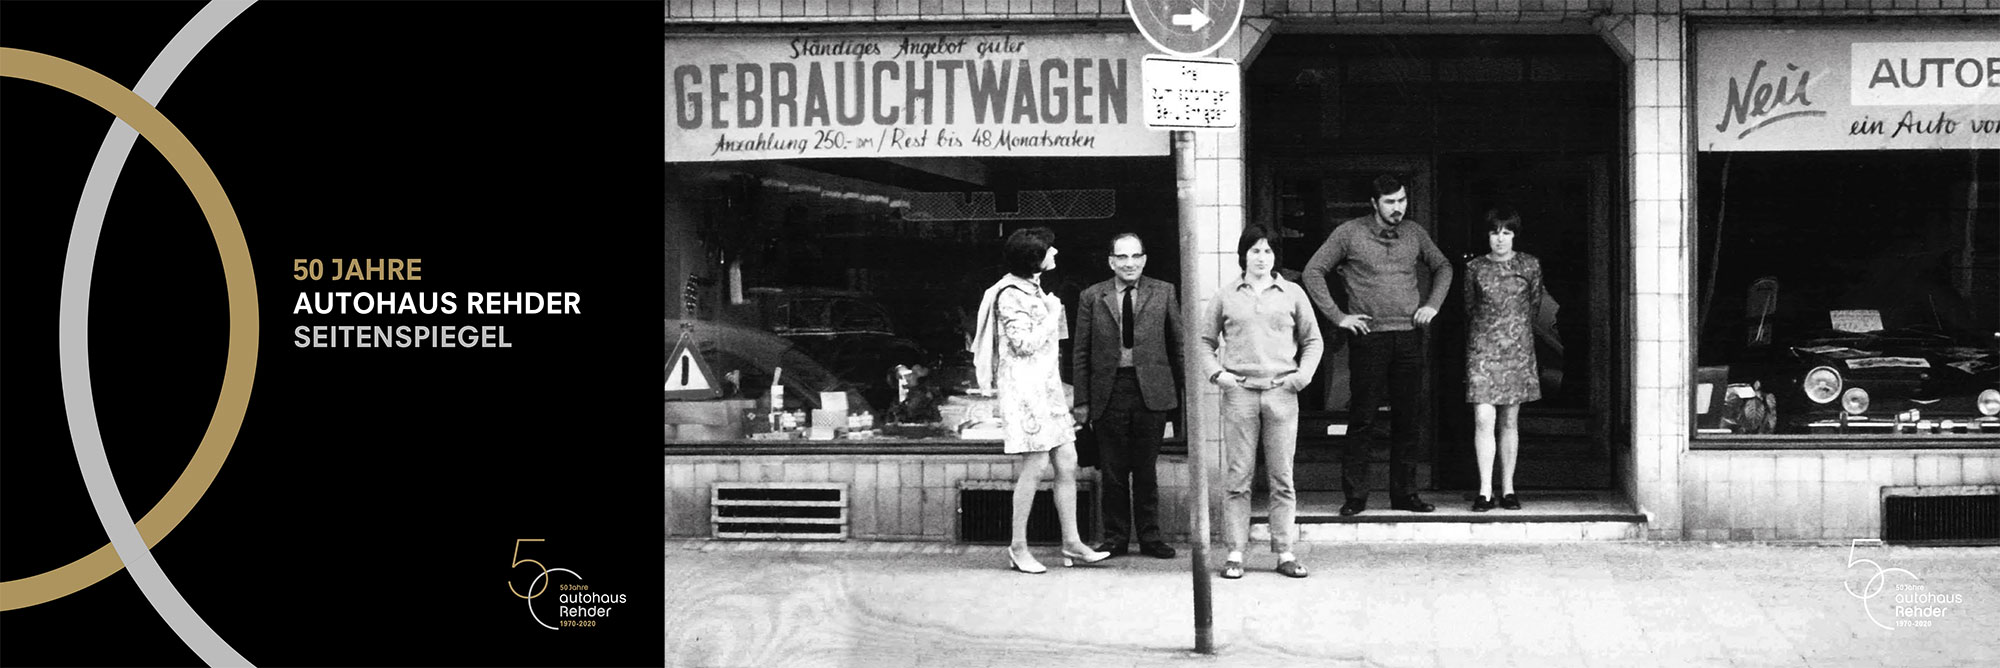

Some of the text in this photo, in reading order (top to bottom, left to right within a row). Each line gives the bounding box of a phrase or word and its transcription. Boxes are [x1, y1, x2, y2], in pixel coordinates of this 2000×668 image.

[789, 36, 1026, 60] Ständiges Angebot guter
[674, 58, 1128, 130] GEBRAUCHTWAGEN
[1848, 115, 1884, 136] ein
[1891, 110, 1956, 138] Auto
[712, 133, 808, 156] Anzahlung
[891, 127, 928, 150] Rest
[937, 125, 963, 148] bis
[971, 127, 992, 148] 48
[994, 126, 1095, 151] Monatsraten
